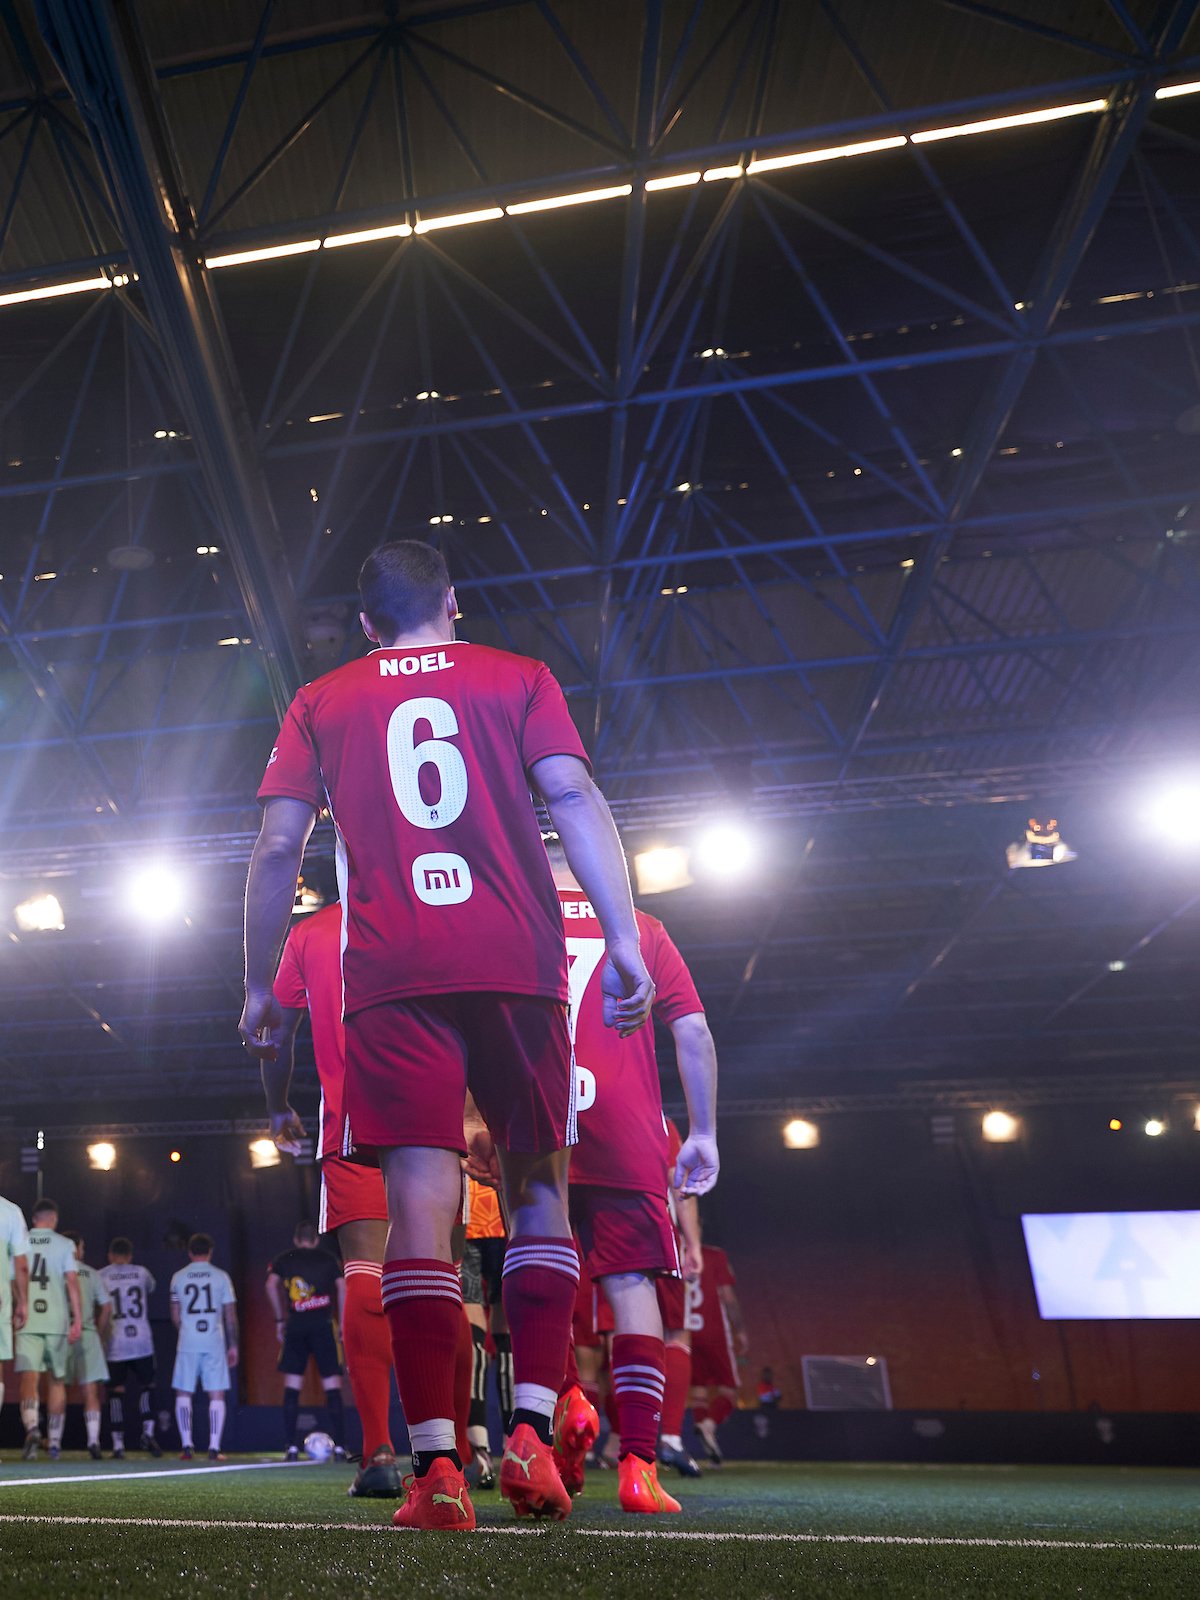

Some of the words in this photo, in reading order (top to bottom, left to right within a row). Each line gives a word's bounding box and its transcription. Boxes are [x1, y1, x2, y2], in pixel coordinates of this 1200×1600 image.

[379, 651, 454, 677] NOEL
[386, 696, 468, 830] 6
[560, 901, 597, 919] ER
[30, 1253, 50, 1290] 4
[109, 1286, 143, 1320] 13
[184, 1283, 216, 1314] 21
